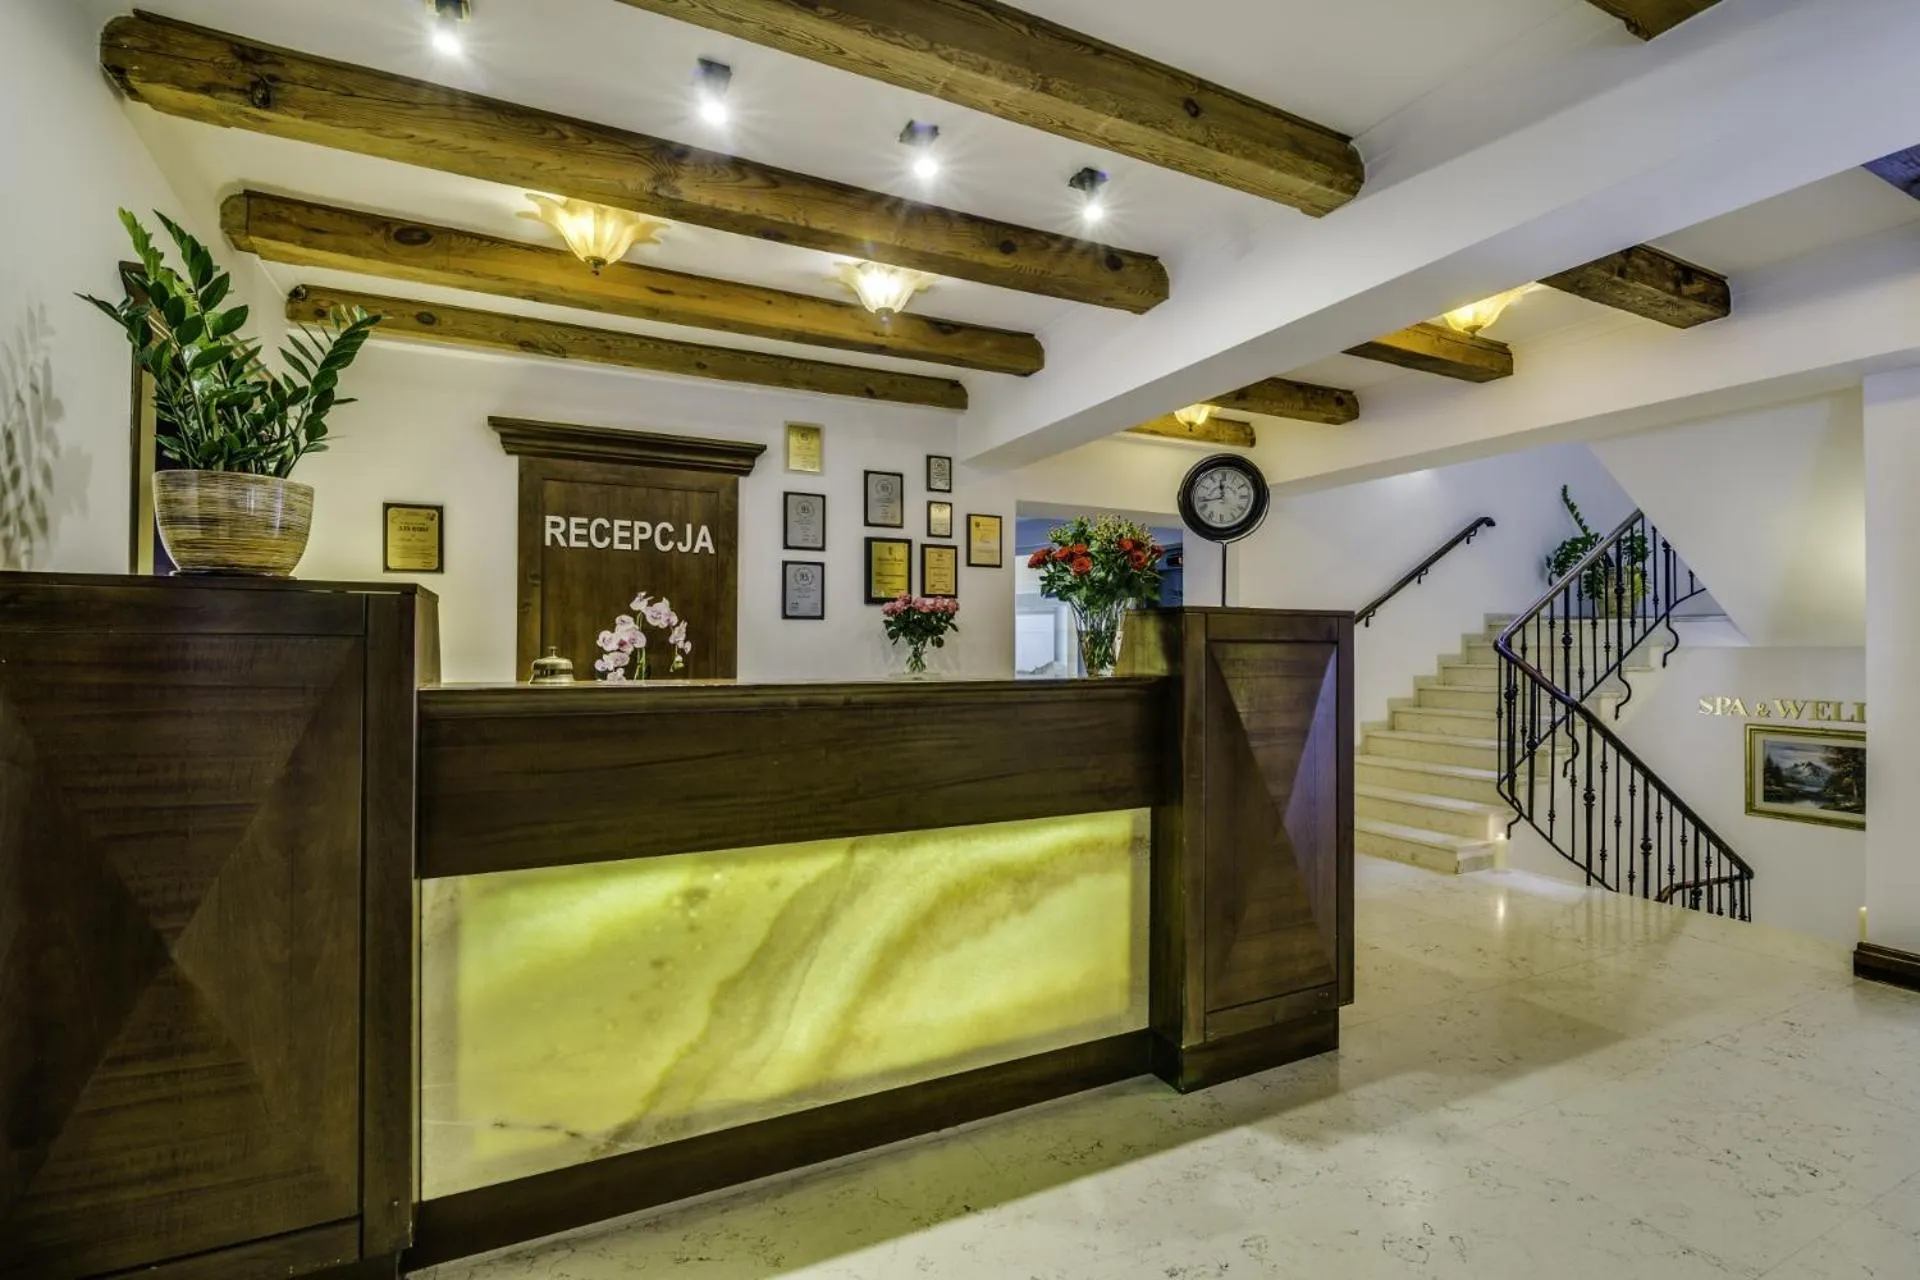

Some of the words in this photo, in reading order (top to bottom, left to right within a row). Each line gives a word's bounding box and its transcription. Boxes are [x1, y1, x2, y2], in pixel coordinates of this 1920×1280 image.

[544, 515, 716, 554] RECEPCJA
[1698, 695, 1750, 717] SPA
[1756, 702, 1771, 717] &
